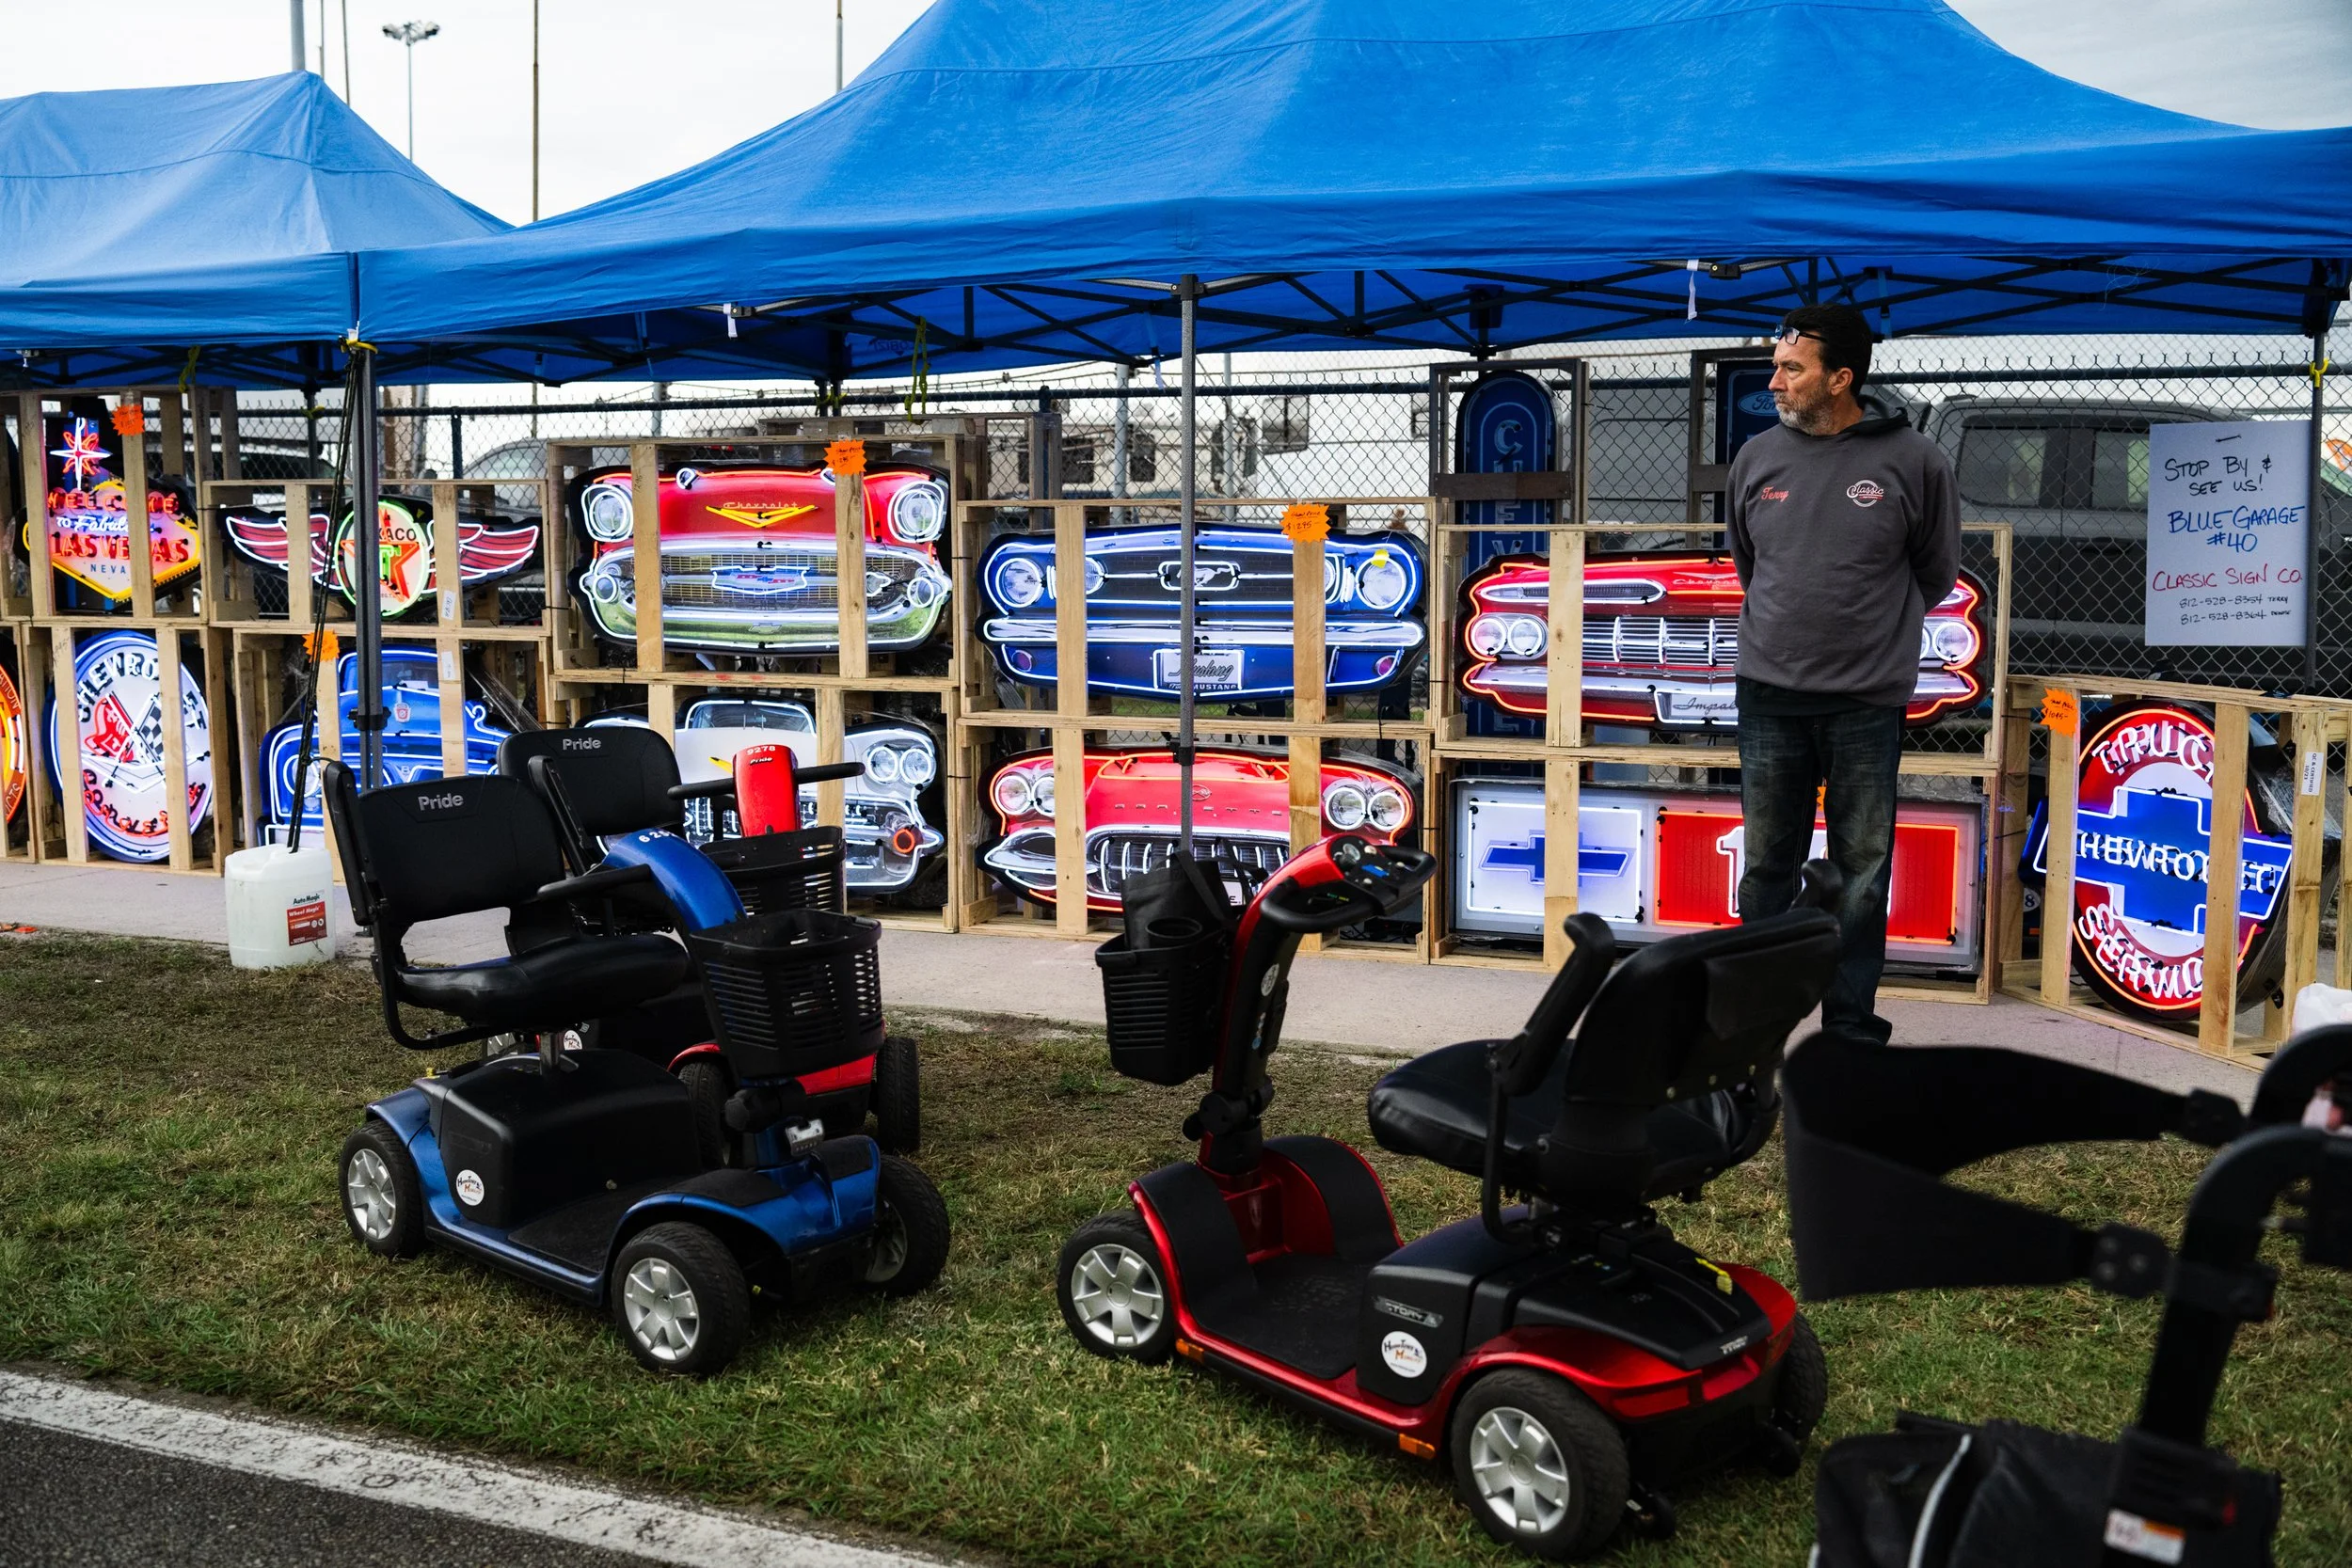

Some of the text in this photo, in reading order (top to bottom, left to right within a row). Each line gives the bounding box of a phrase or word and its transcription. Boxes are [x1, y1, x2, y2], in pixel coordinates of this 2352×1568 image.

[2165, 458, 2210, 482] STOP
[1761, 487, 1789, 502] Terry
[2189, 481, 2222, 497] SEE
[723, 501, 799, 510] Chevrolet
[2168, 505, 2306, 533] BLUE GARAGE
[100, 534, 189, 563] VEAS
[2206, 532, 2258, 553] #40
[90, 564, 126, 574] NEVA
[2153, 570, 2217, 592] CLASSIC
[2225, 562, 2268, 585] SIGN
[1168, 657, 1234, 682] ustang
[78, 652, 206, 730] CHEVROET
[1672, 697, 1739, 716] Impal
[563, 737, 602, 751] Pride
[747, 745, 776, 755] 9278
[750, 756, 773, 765] Pride
[418, 792, 464, 811] Pride
[2075, 832, 2284, 895] HEVROET
